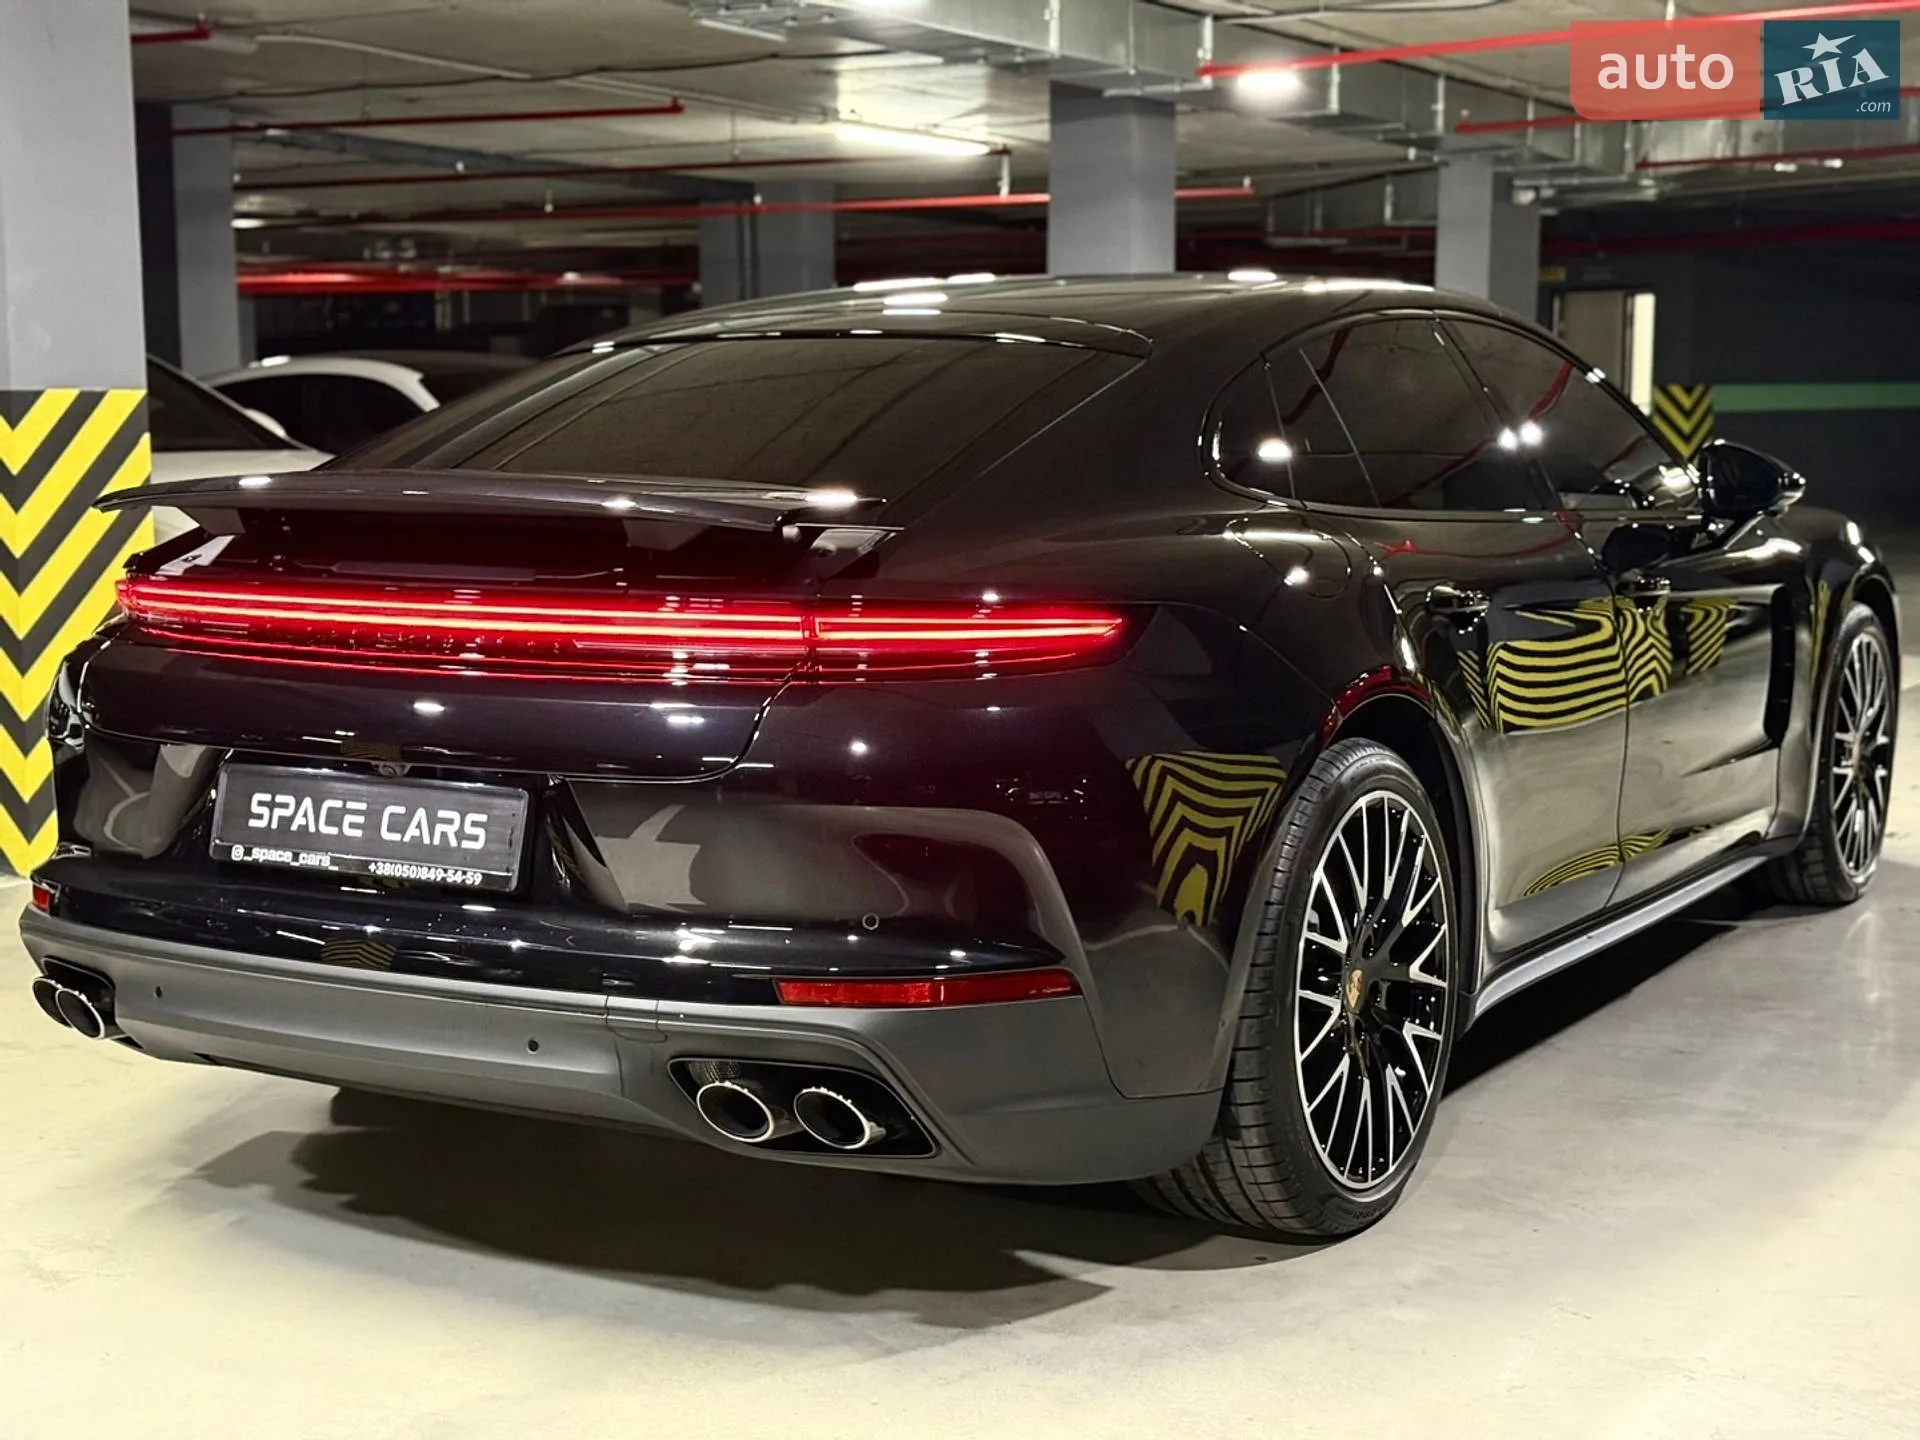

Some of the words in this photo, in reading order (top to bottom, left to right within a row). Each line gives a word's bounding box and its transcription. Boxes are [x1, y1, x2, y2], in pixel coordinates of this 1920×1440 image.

[248, 792, 367, 837] SPACE
[380, 805, 488, 850] CARS
[368, 862, 482, 886] +38(050)849-54-59
